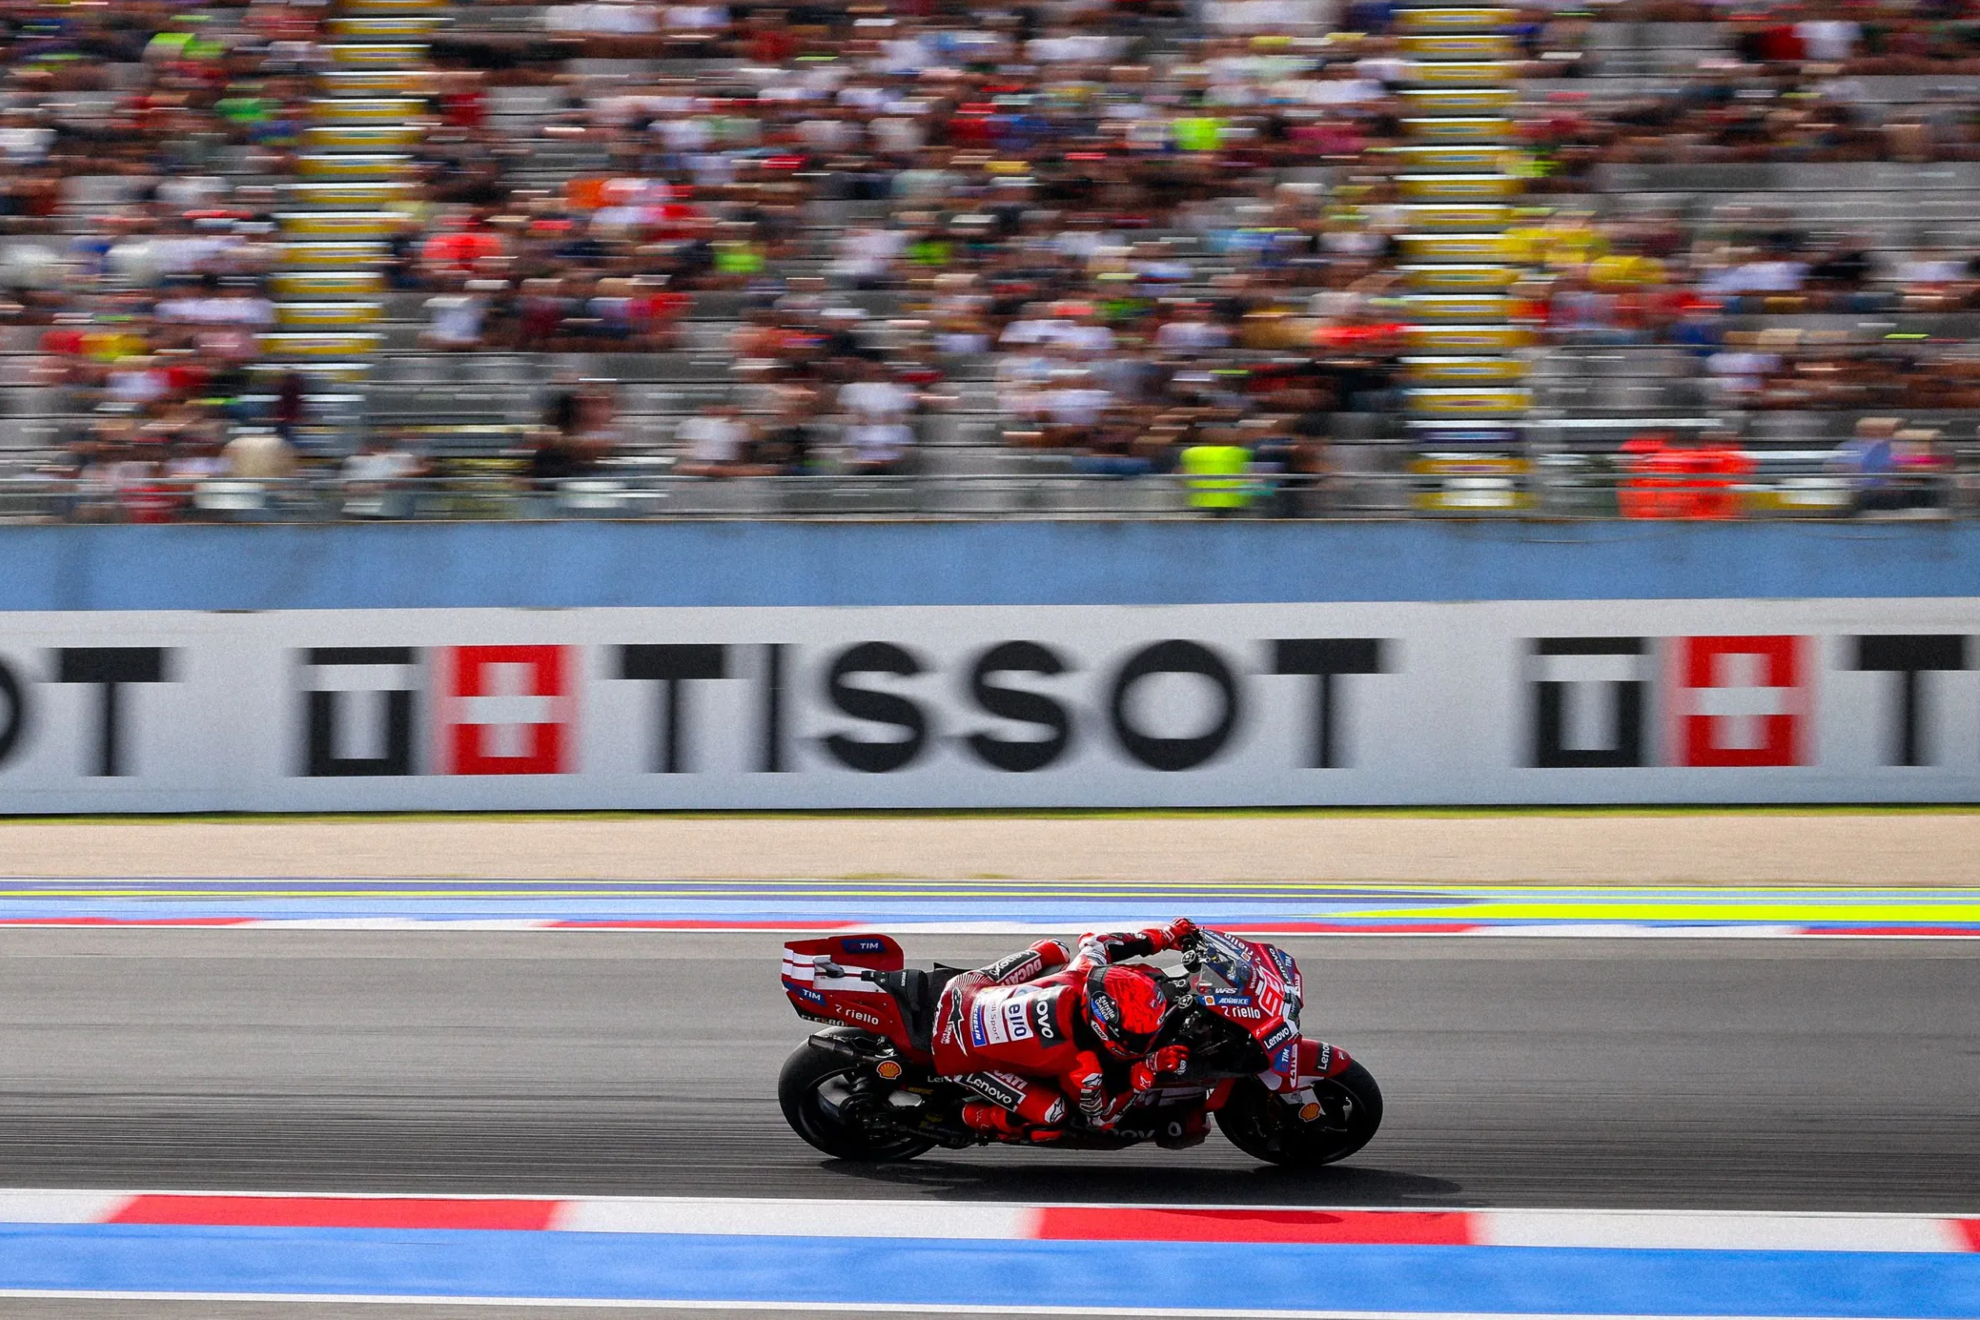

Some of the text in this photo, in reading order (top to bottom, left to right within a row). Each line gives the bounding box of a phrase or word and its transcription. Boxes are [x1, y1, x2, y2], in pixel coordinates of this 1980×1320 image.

[598, 637, 1397, 773] TISSOT
[859, 942, 879, 950] TIM
[1224, 932, 1254, 956] riello
[1269, 947, 1292, 985] Lenovo
[802, 989, 821, 1001] TIM
[845, 1008, 880, 1025] riello
[1232, 1007, 1261, 1019] riello
[990, 1013, 1000, 1041] Sport
[1263, 1026, 1290, 1050] Lenovo
[1281, 1048, 1290, 1063] TIM
[966, 1073, 1013, 1105] Lenovo
